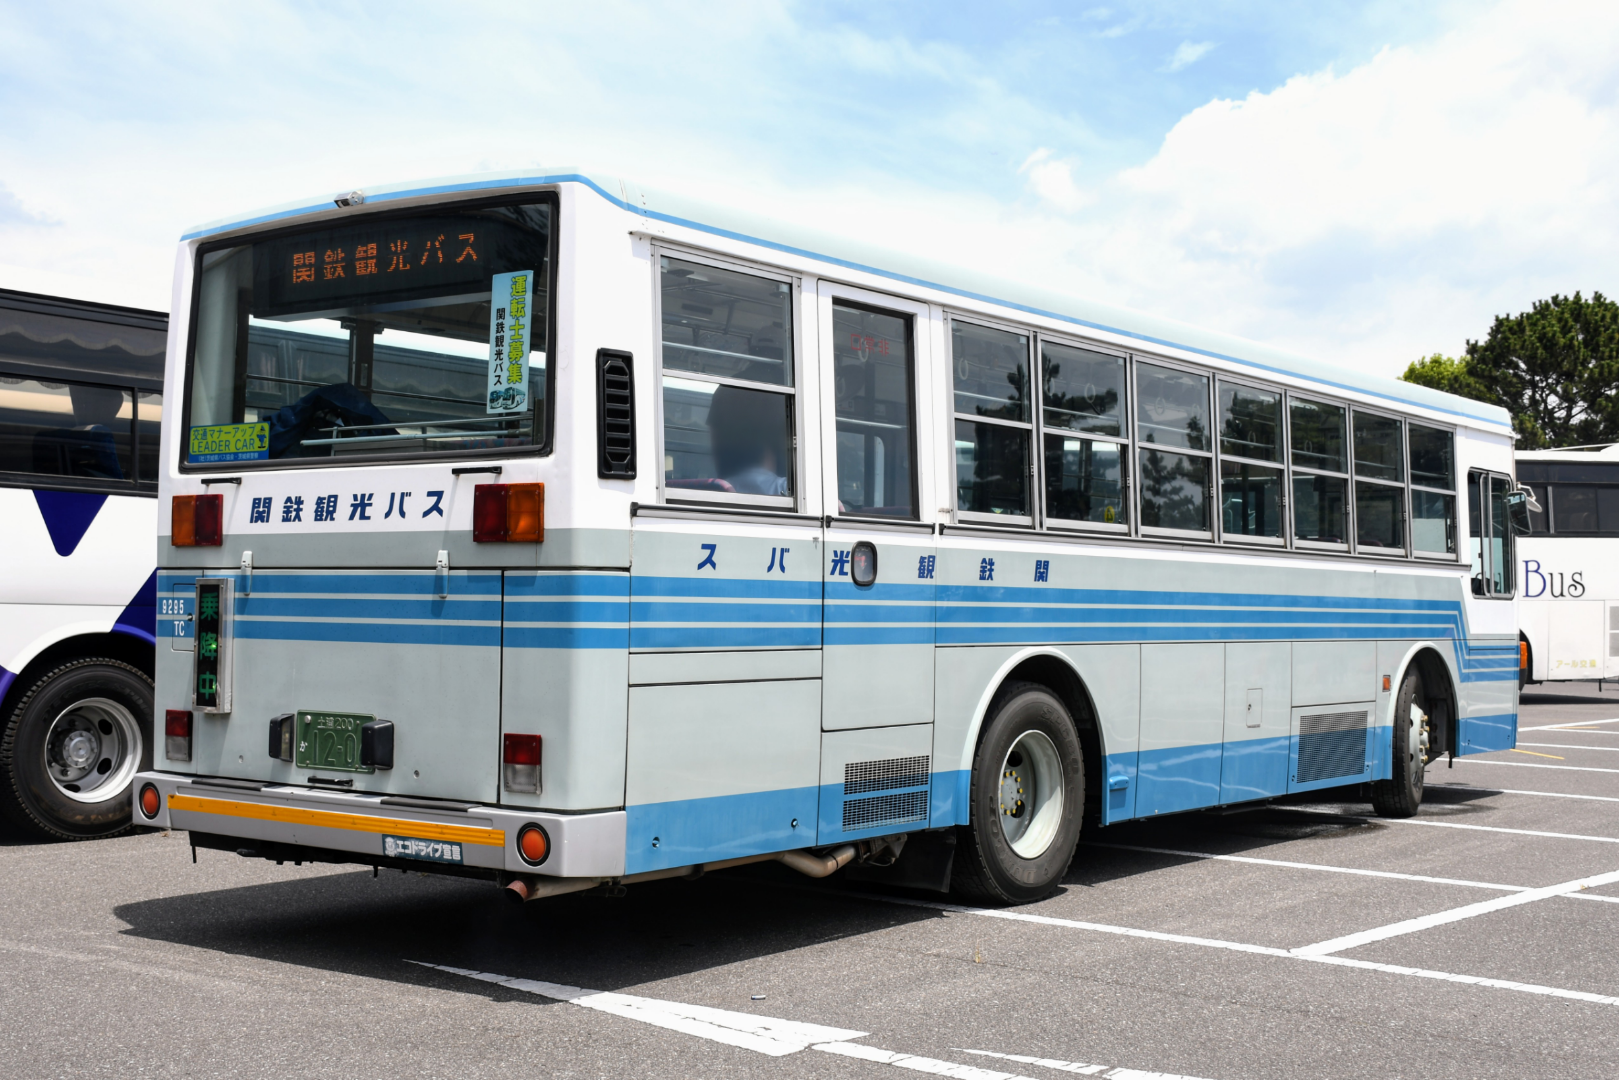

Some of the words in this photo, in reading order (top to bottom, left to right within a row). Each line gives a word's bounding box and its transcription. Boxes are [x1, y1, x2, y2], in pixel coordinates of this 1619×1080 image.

[292, 233, 478, 284] 関鉄観光バス
[493, 307, 506, 387] 関鉄観光バス
[507, 275, 527, 385] 運転士募集
[191, 439, 231, 454] LEADER
[234, 438, 256, 451] CAR
[192, 424, 257, 441] 交通マナーアップ
[249, 490, 445, 523] 関鉄観光バス
[1521, 559, 1586, 598] Bus
[162, 599, 185, 614] 9295
[173, 620, 185, 636] TC
[199, 591, 219, 700] 乗降中
[313, 729, 363, 768] 12-0
[396, 840, 461, 860] エコドライブ宣言
